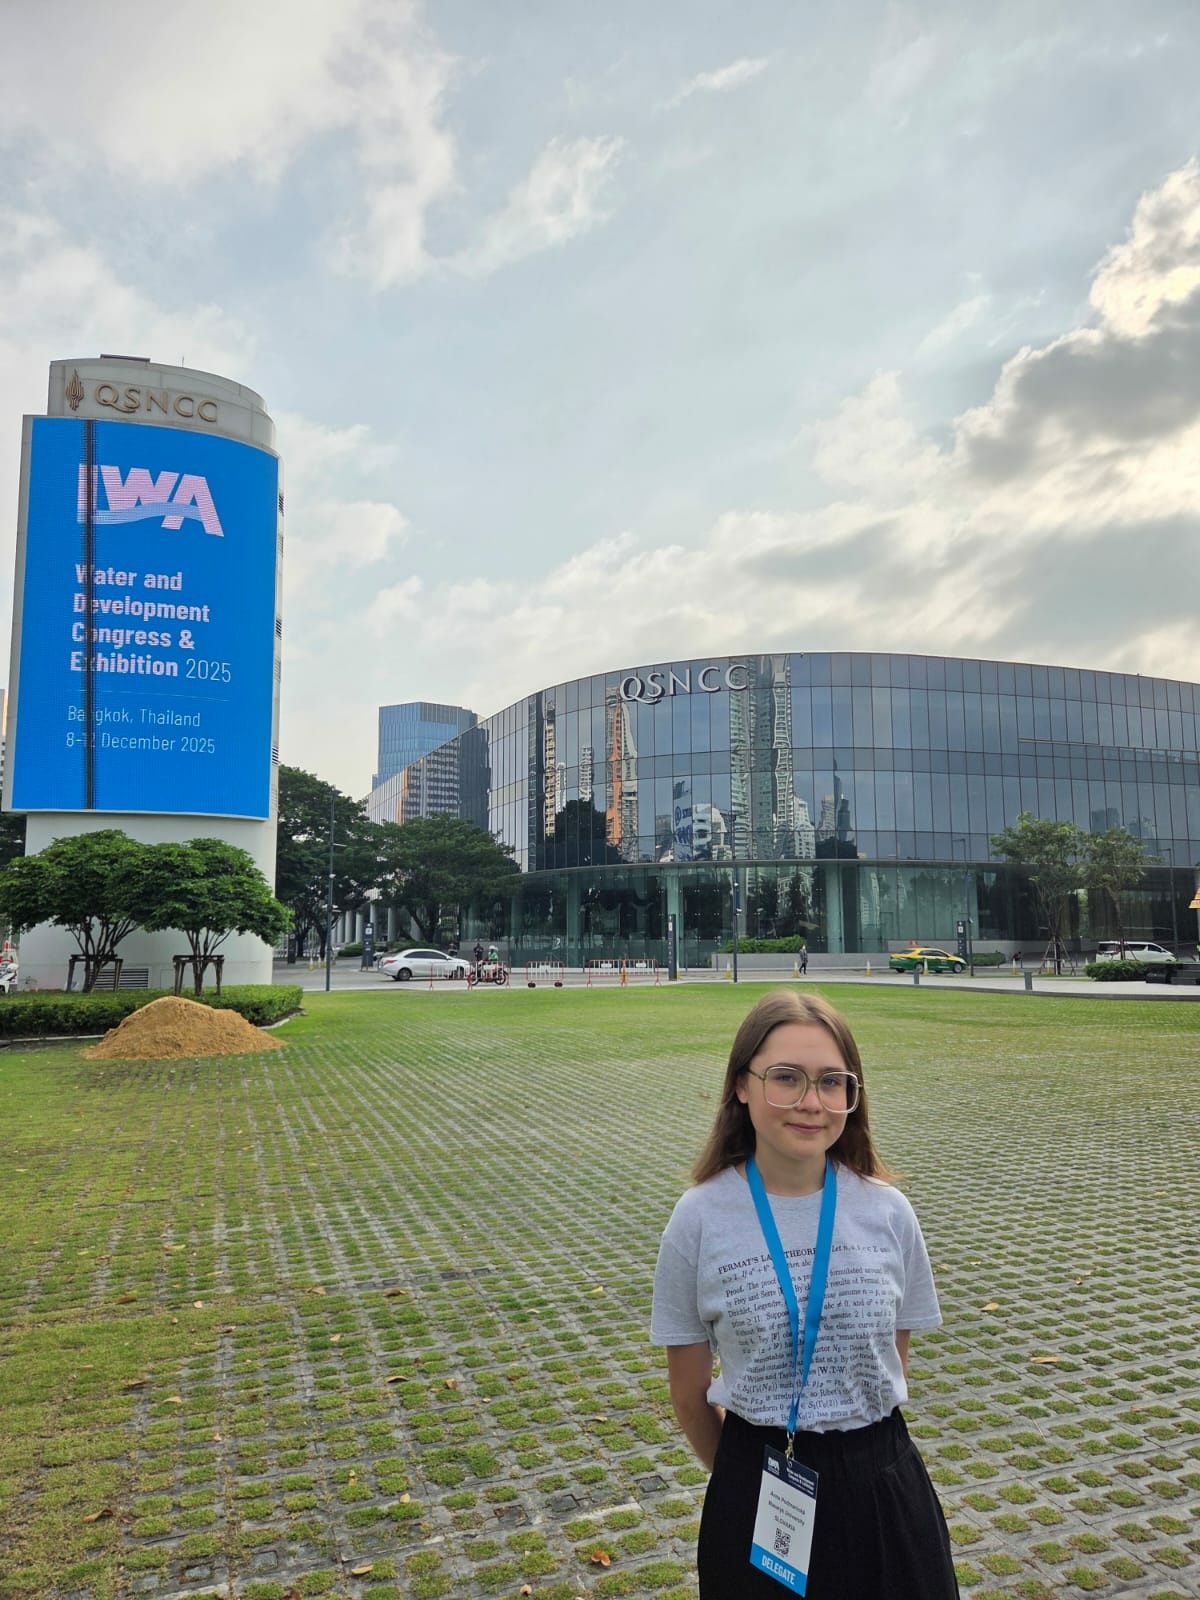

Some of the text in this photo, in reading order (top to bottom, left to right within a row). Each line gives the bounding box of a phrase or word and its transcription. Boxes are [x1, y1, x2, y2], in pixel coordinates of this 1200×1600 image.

[94, 383, 218, 423] QSNCC
[77, 463, 224, 537] IWA
[144, 572, 182, 590] and
[179, 629, 195, 649] &
[185, 658, 231, 682] 2025
[619, 664, 747, 704] QSNCC
[68, 706, 200, 727] Bagkok, Thailand
[102, 733, 175, 750] December
[180, 737, 215, 753] 2025
[762, 1555, 796, 1585] DELEGATE
